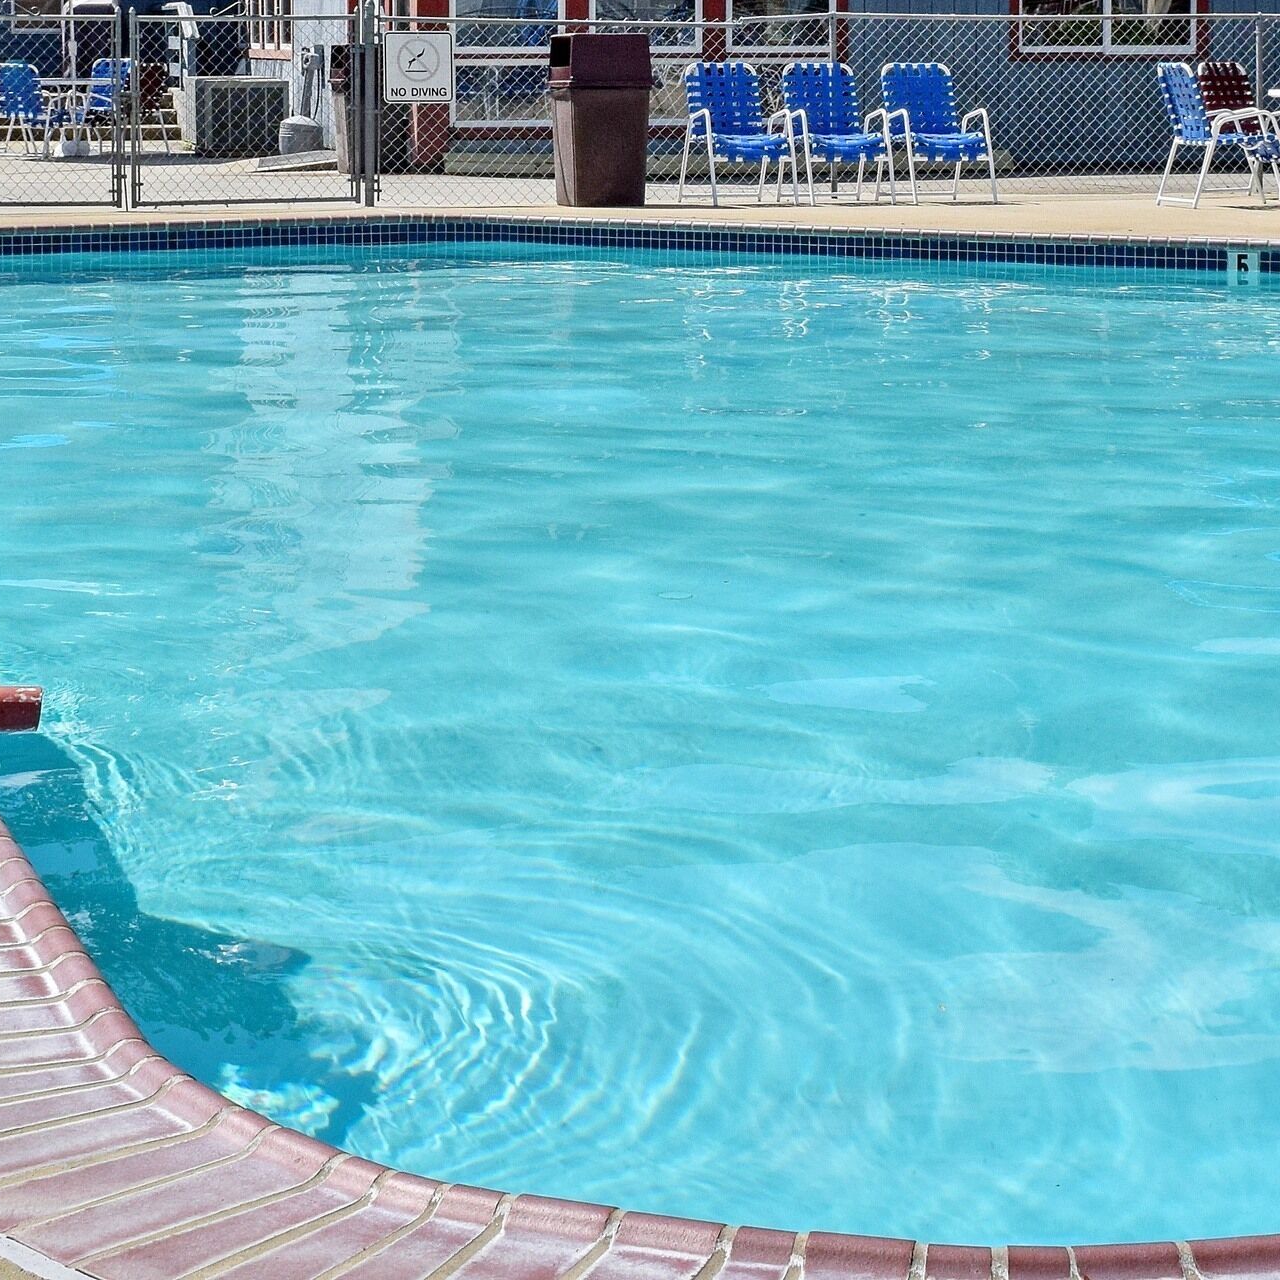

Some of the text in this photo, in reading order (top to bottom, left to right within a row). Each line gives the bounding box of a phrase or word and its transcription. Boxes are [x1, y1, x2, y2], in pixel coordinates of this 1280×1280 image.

[390, 87, 447, 97] NO DIVING
[1237, 253, 1249, 272] 5
